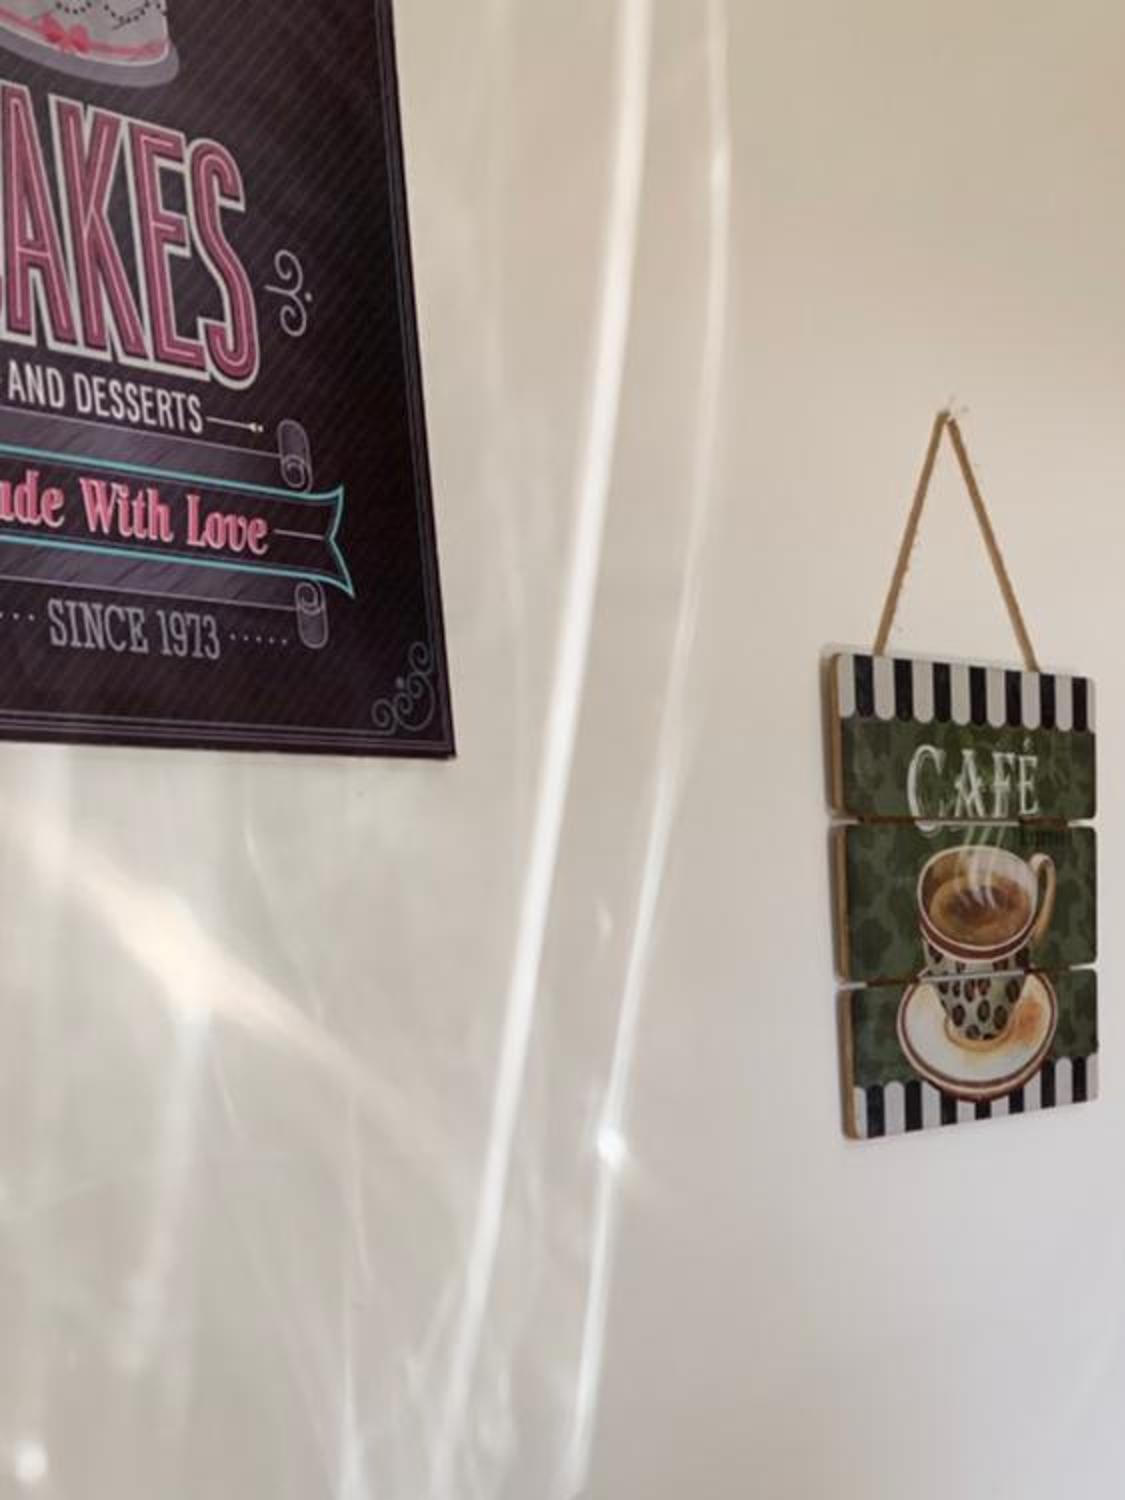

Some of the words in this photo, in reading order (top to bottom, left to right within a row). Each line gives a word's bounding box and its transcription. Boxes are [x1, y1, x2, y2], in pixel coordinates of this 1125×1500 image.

[0, 78, 260, 390] AKES
[7, 360, 66, 402] AND
[76, 371, 204, 434] DESSERTS
[79, 476, 174, 542] With
[185, 494, 269, 555] Love
[48, 597, 149, 655] SINCE
[157, 609, 221, 660] 1973
[906, 737, 1040, 838] CAFÉ
